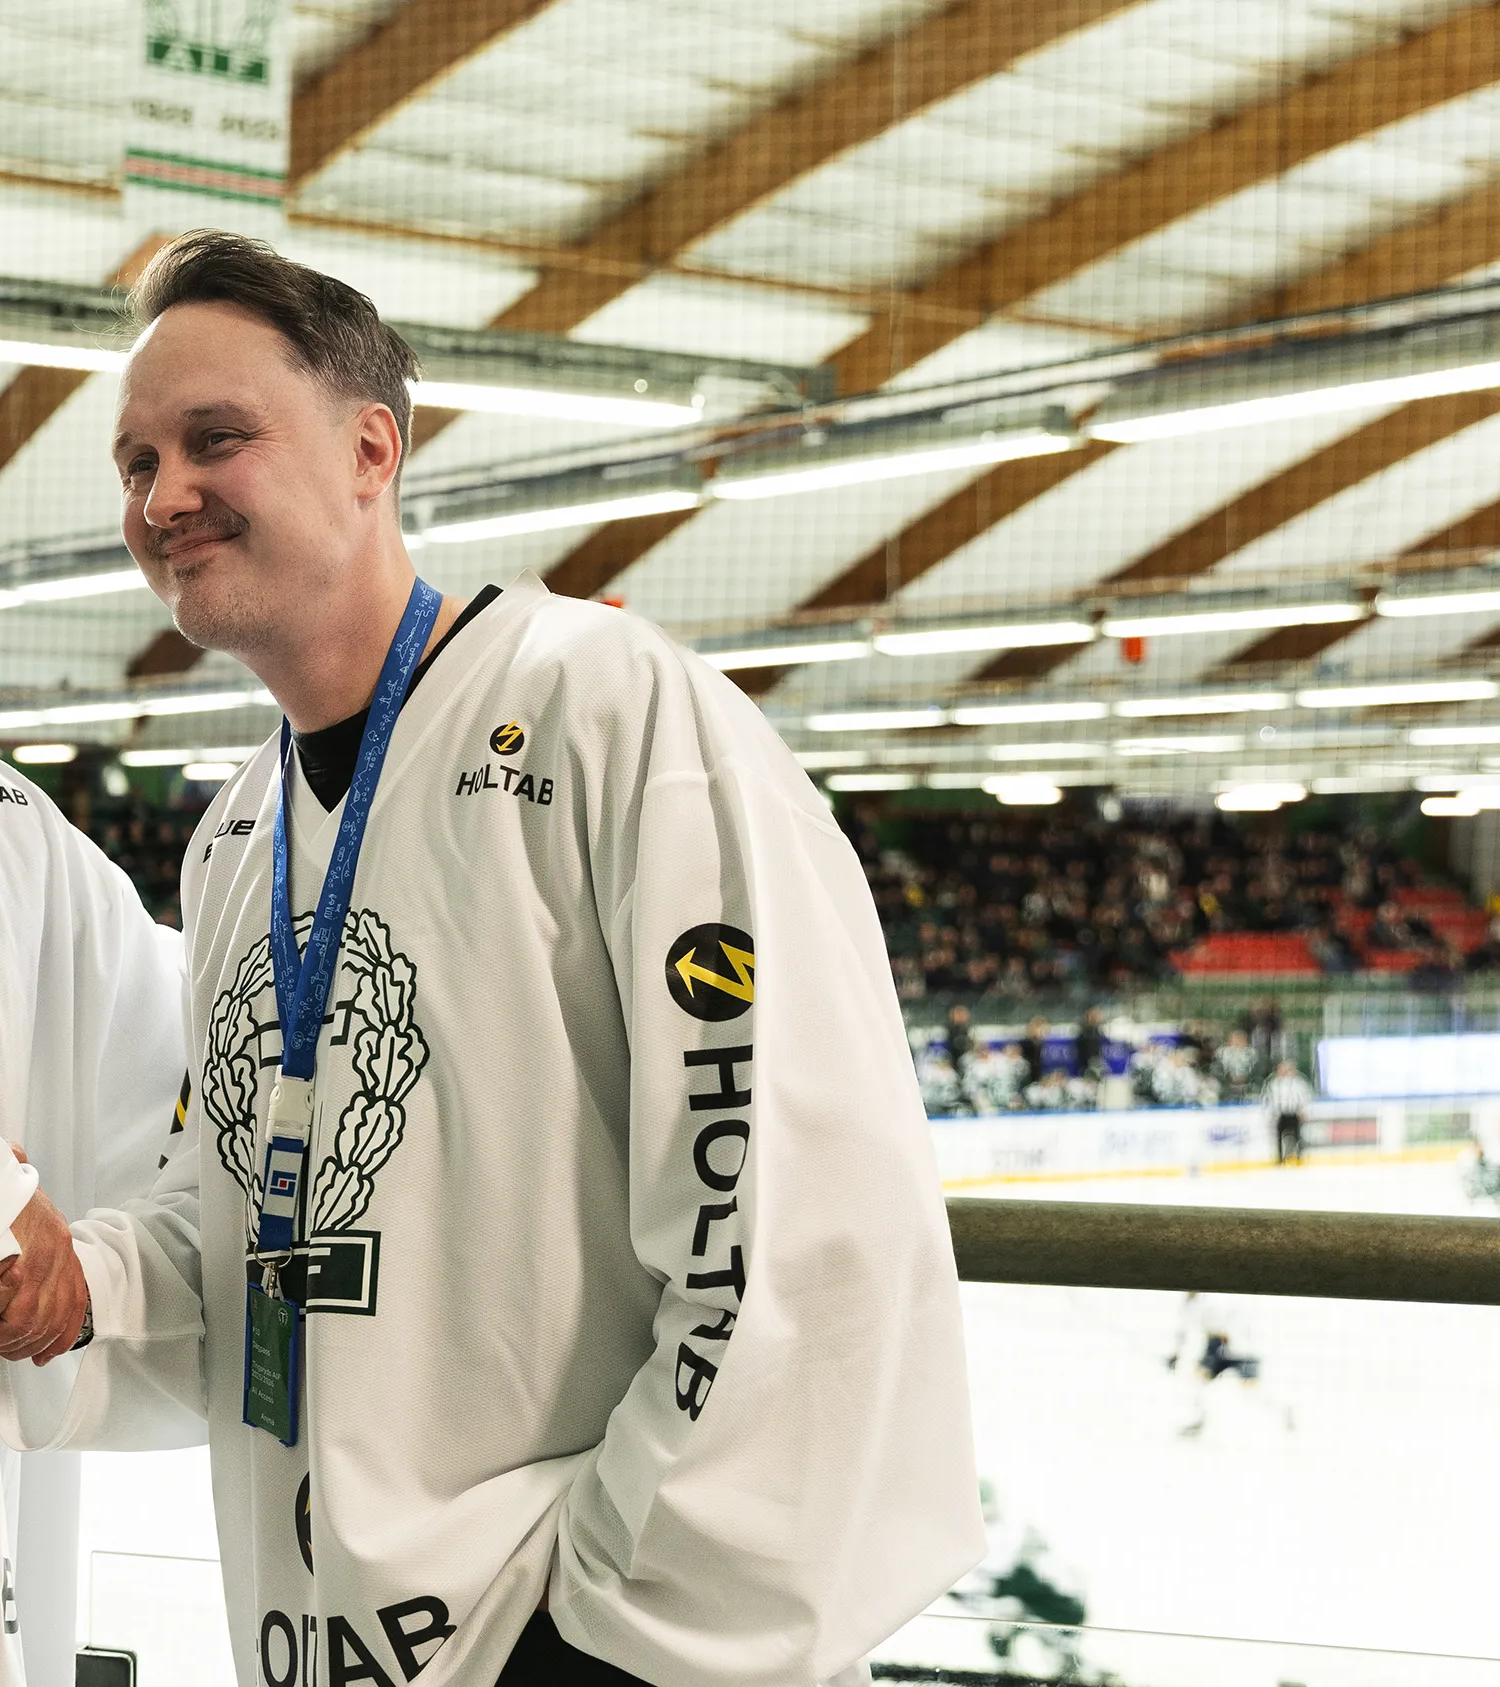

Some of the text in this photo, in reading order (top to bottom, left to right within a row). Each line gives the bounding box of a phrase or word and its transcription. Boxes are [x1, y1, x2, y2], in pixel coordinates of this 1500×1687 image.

[456, 763, 554, 806] HOLTAB
[258, 1390, 274, 1404] Access
[260, 1412, 275, 1426] Arena
